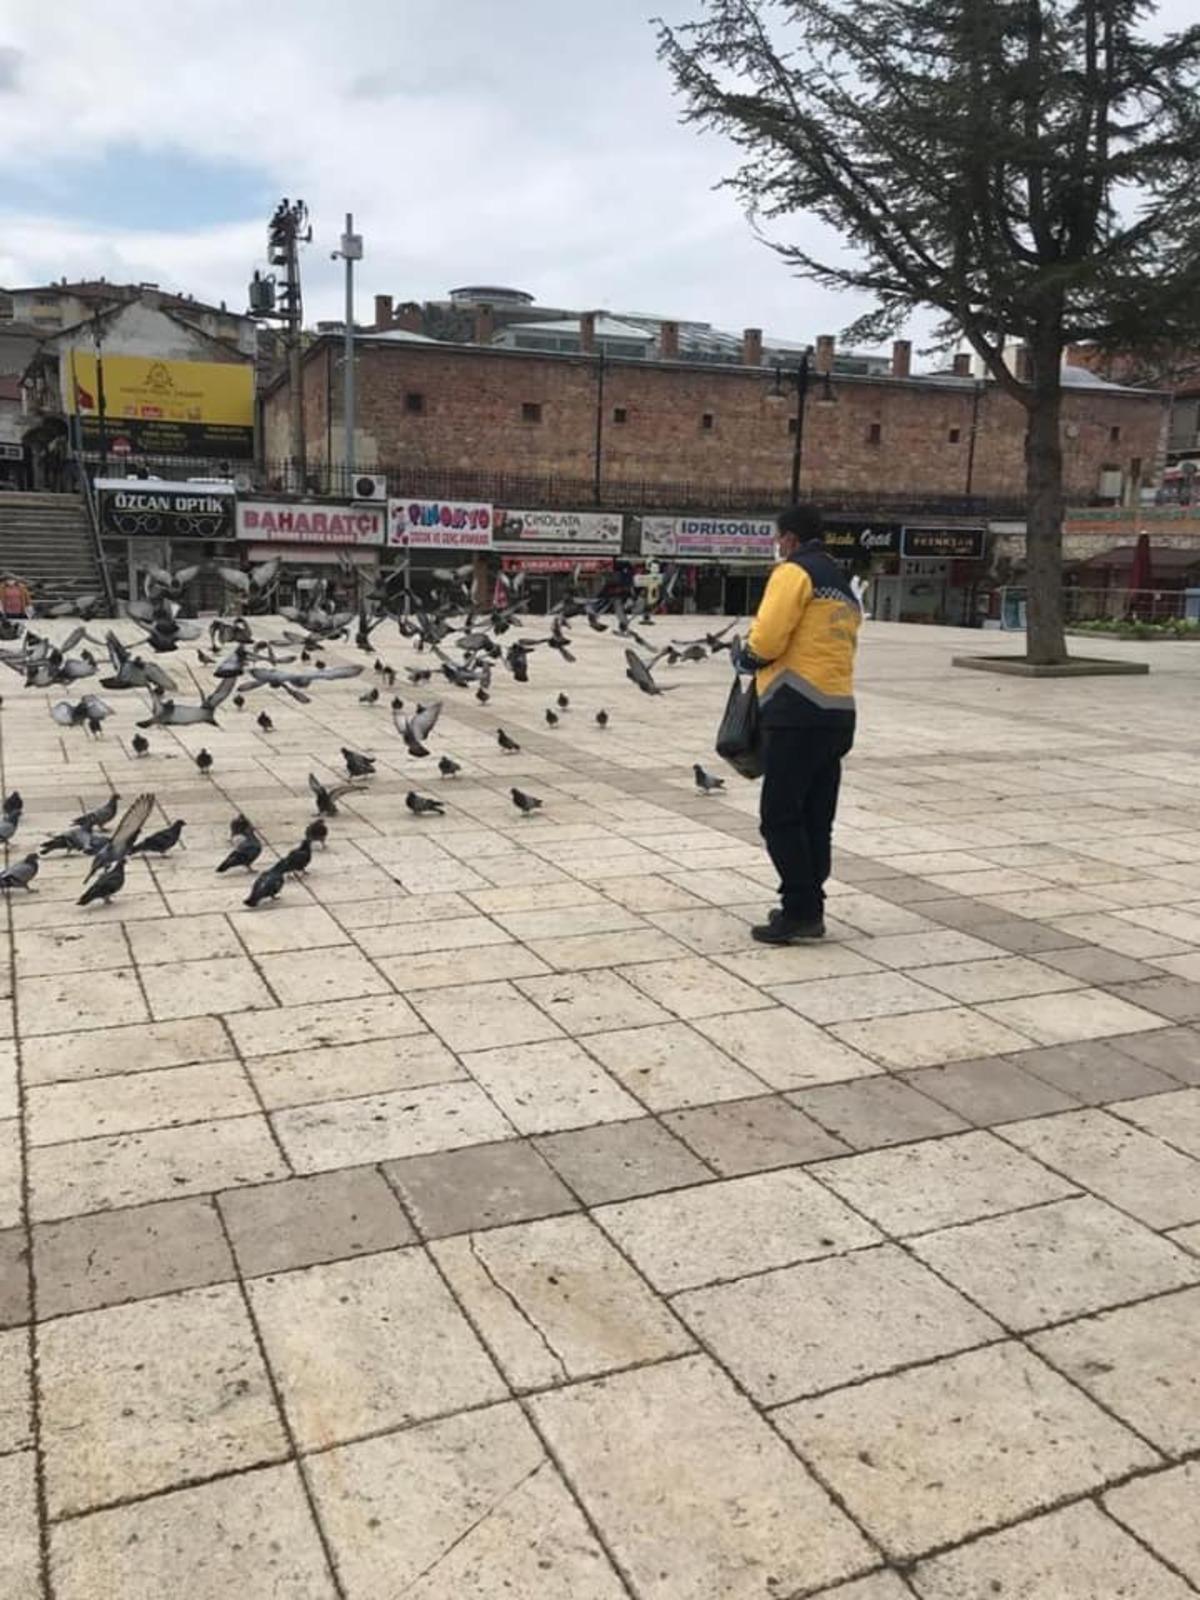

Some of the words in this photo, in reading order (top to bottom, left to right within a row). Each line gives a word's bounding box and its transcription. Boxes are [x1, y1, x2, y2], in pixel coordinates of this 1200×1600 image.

[114, 493, 170, 511] ÖZCAN
[175, 496, 223, 513] OPTİK
[243, 509, 379, 536] BAHARATÇI
